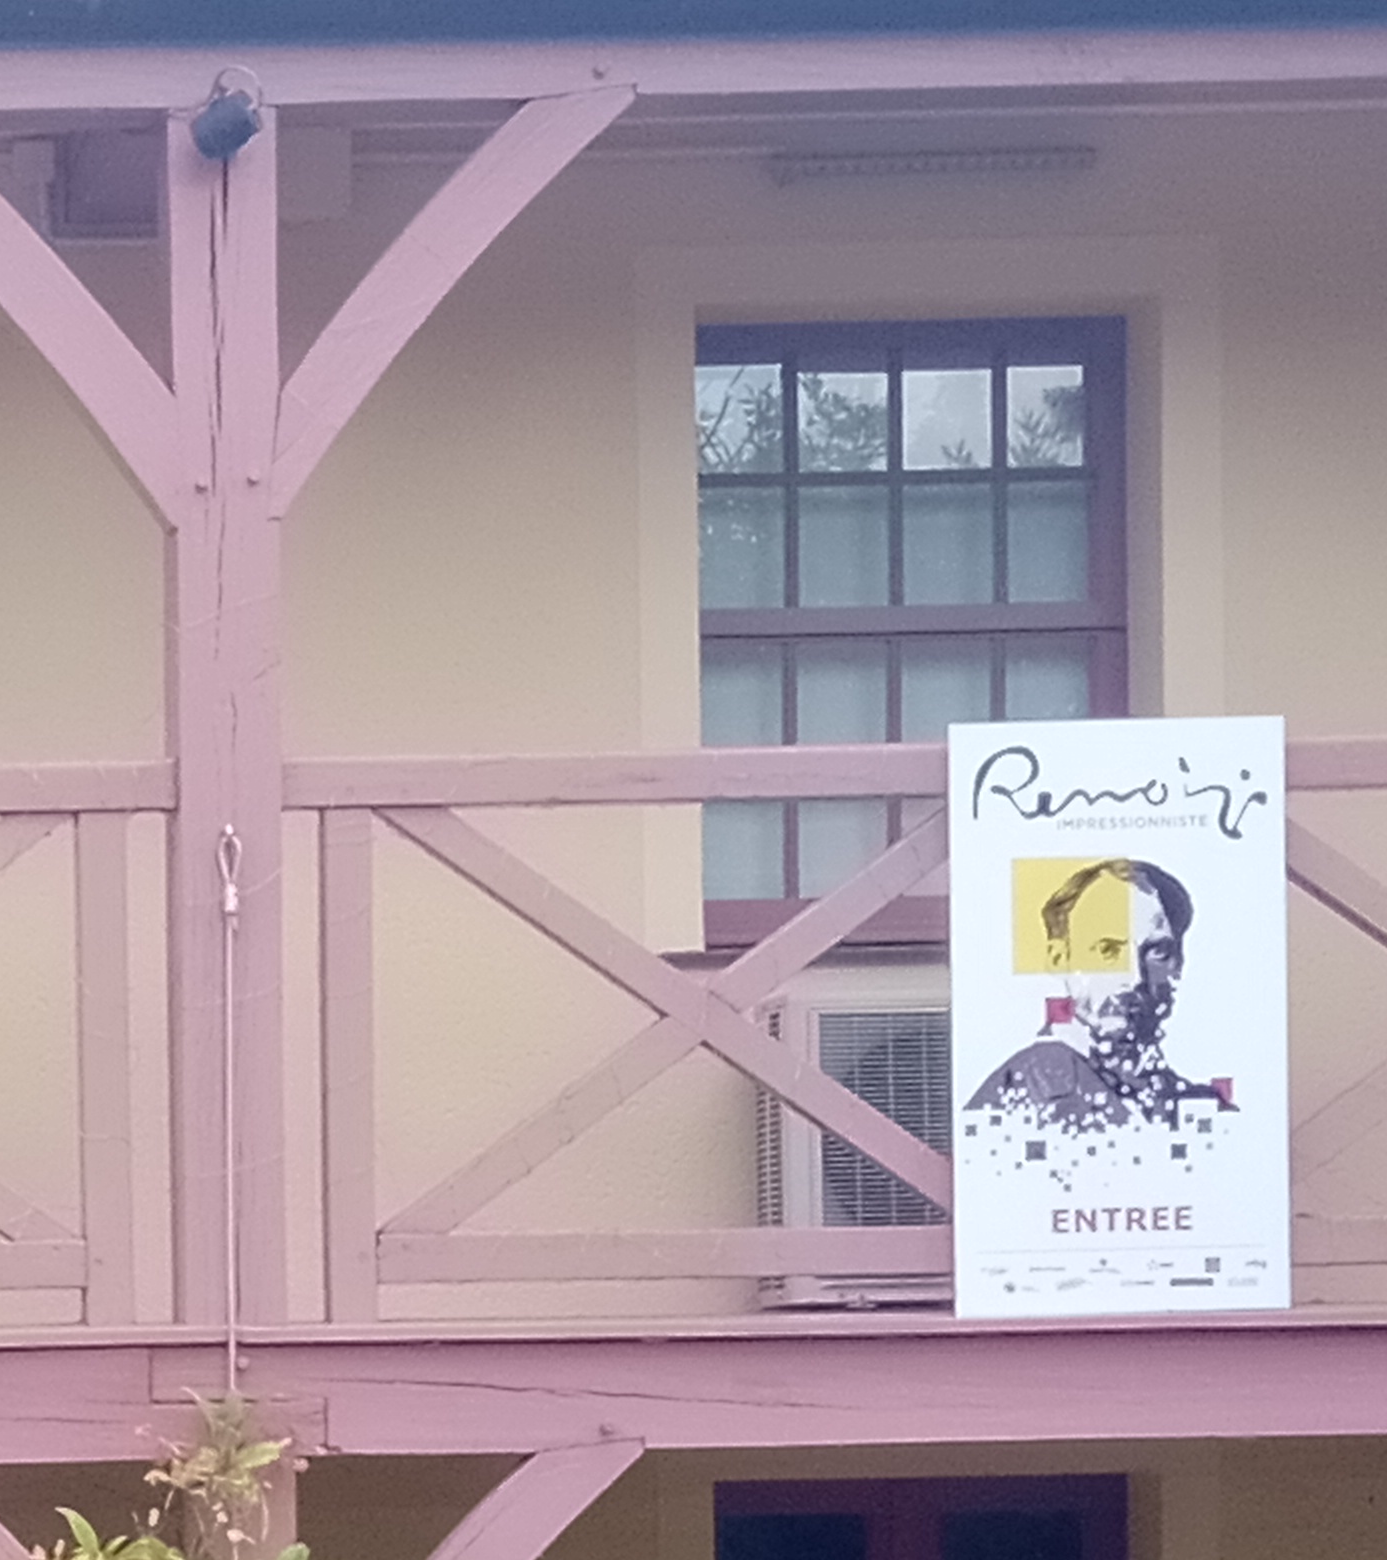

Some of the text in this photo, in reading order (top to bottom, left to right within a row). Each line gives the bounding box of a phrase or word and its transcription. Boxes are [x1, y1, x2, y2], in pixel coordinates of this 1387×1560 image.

[972, 745, 1268, 840] Renoir
[1056, 814, 1209, 831] IMPRESSIONNISTE
[1051, 1205, 1194, 1234] ENTREE
